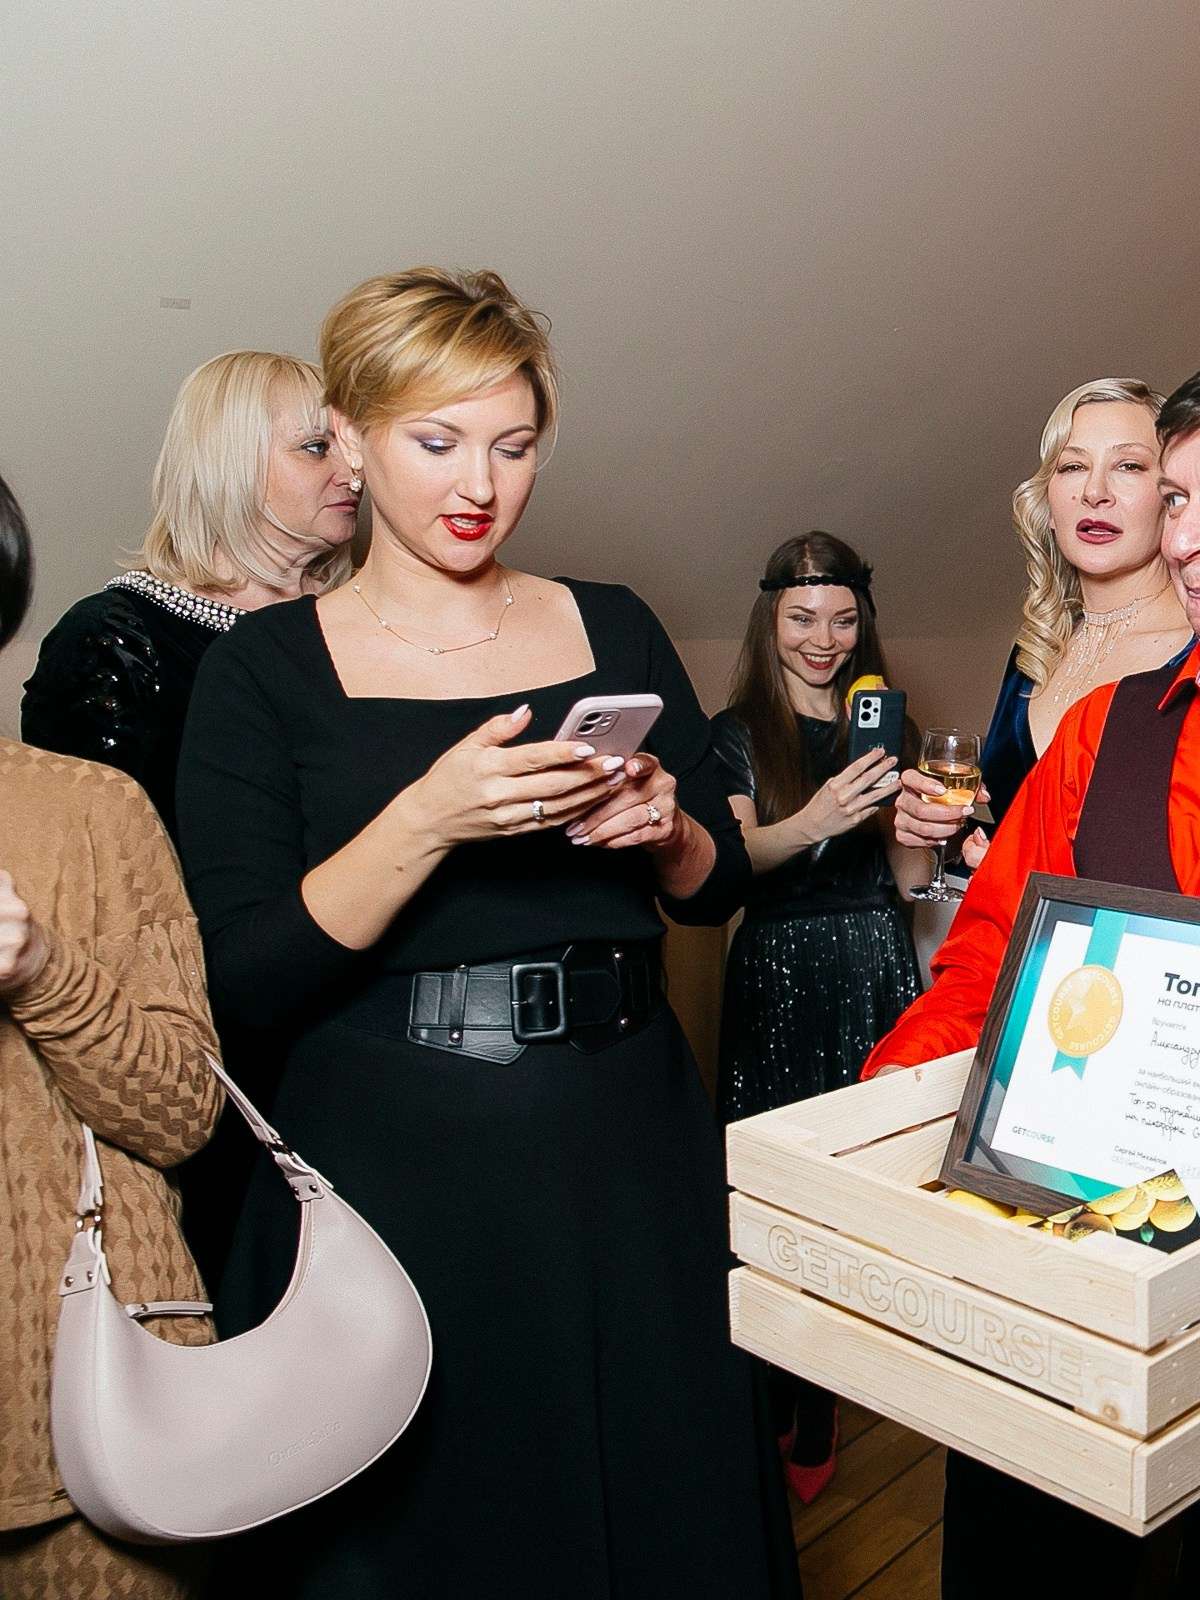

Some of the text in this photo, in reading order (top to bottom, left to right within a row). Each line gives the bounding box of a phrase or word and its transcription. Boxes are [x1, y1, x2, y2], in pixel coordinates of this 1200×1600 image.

[1157, 997, 1172, 1007] на
[1012, 1125, 1056, 1144] GETCOURSE
[767, 1224, 1085, 1397] GETCOURSE
